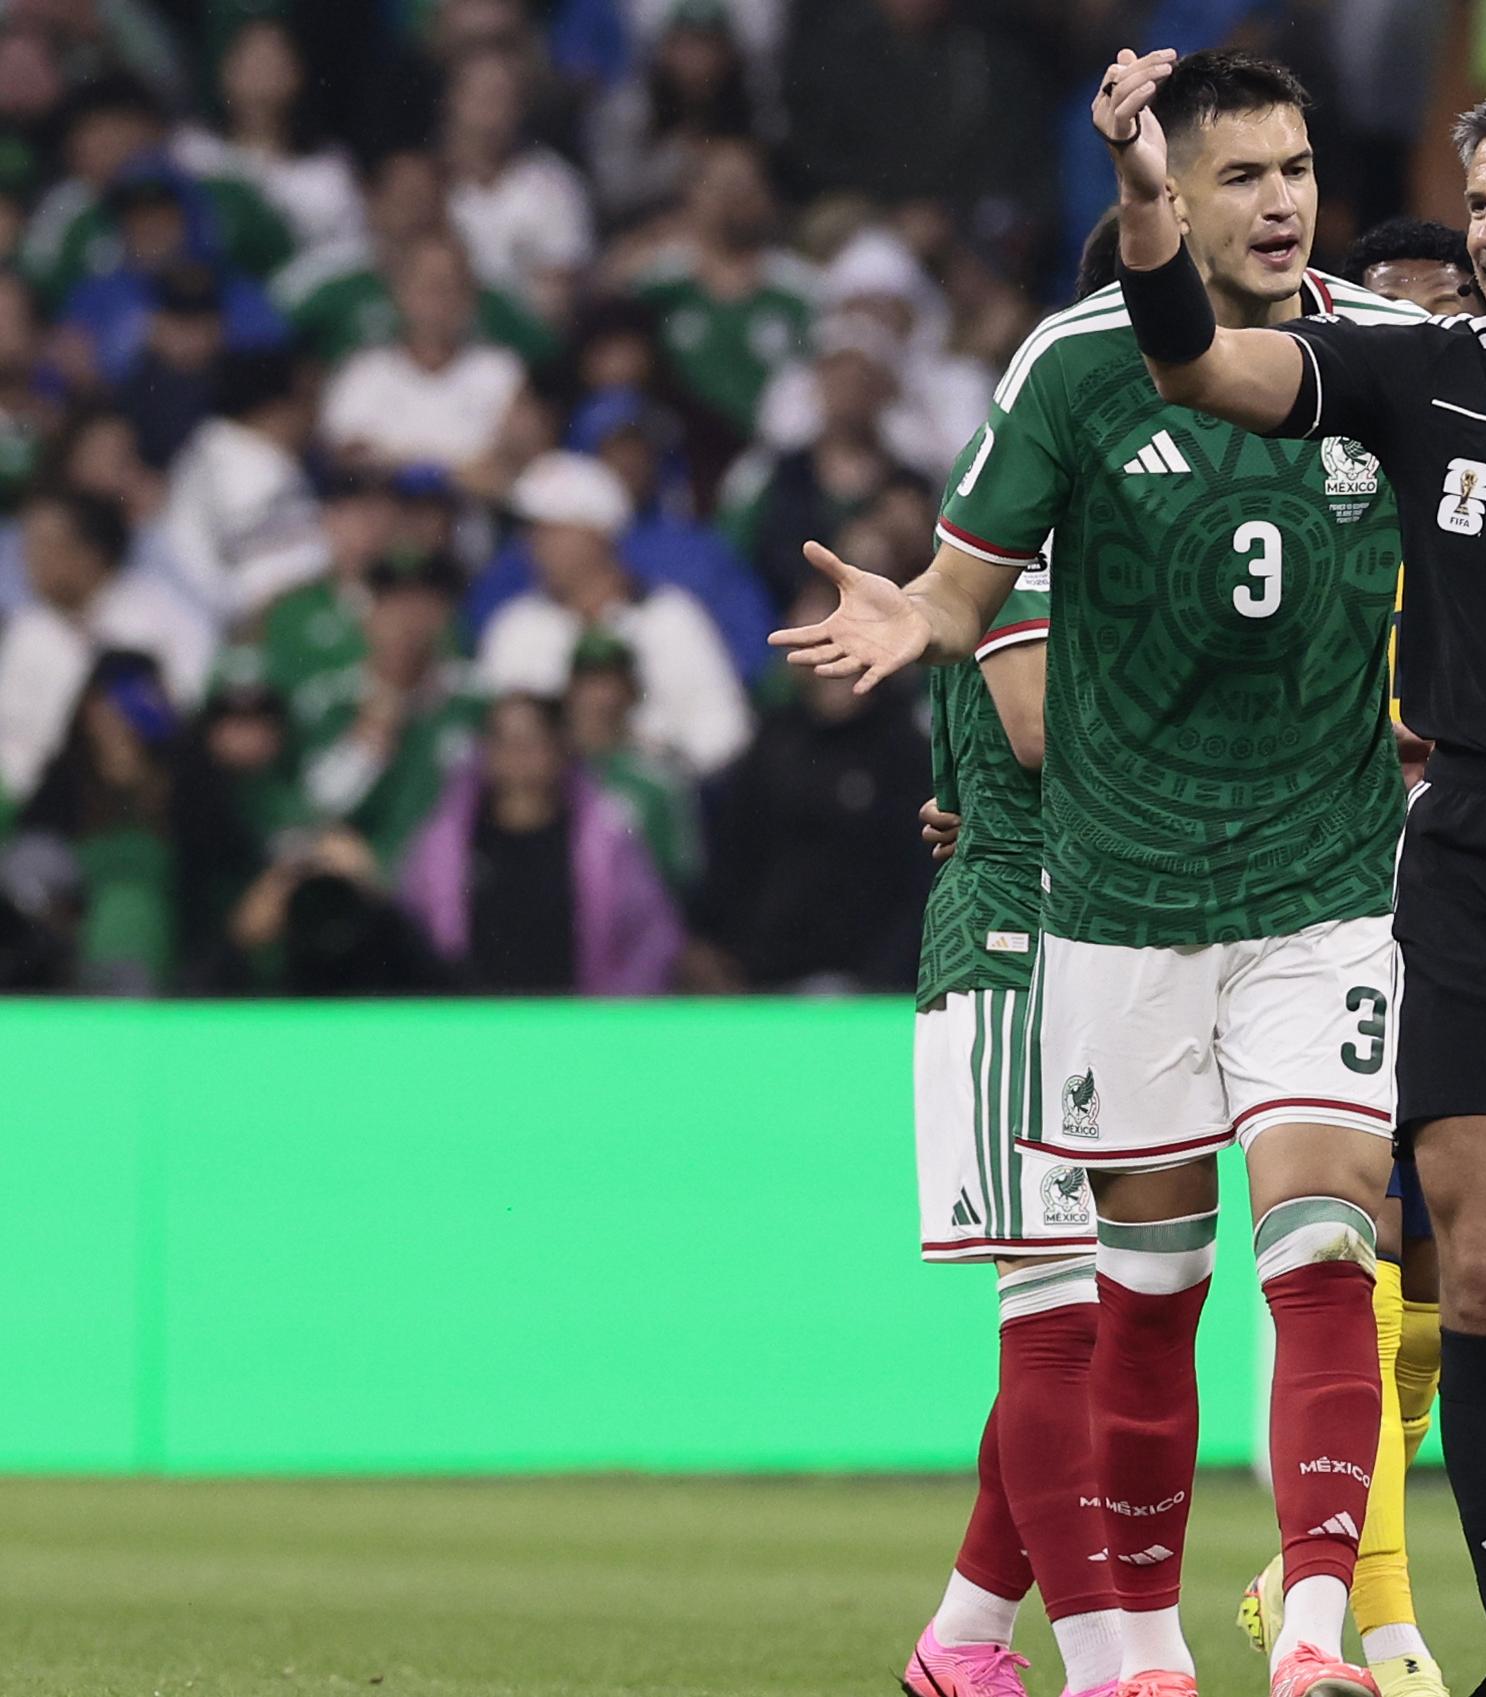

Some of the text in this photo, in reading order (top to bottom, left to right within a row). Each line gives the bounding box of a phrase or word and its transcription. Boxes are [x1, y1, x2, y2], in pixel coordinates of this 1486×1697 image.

[1449, 516, 1470, 528] FIFA
[1232, 519, 1283, 619] 3
[1340, 985, 1388, 1075] 3
[1299, 1456, 1371, 1489] MÉXICO
[1105, 1490, 1185, 1517] MÉXICO
